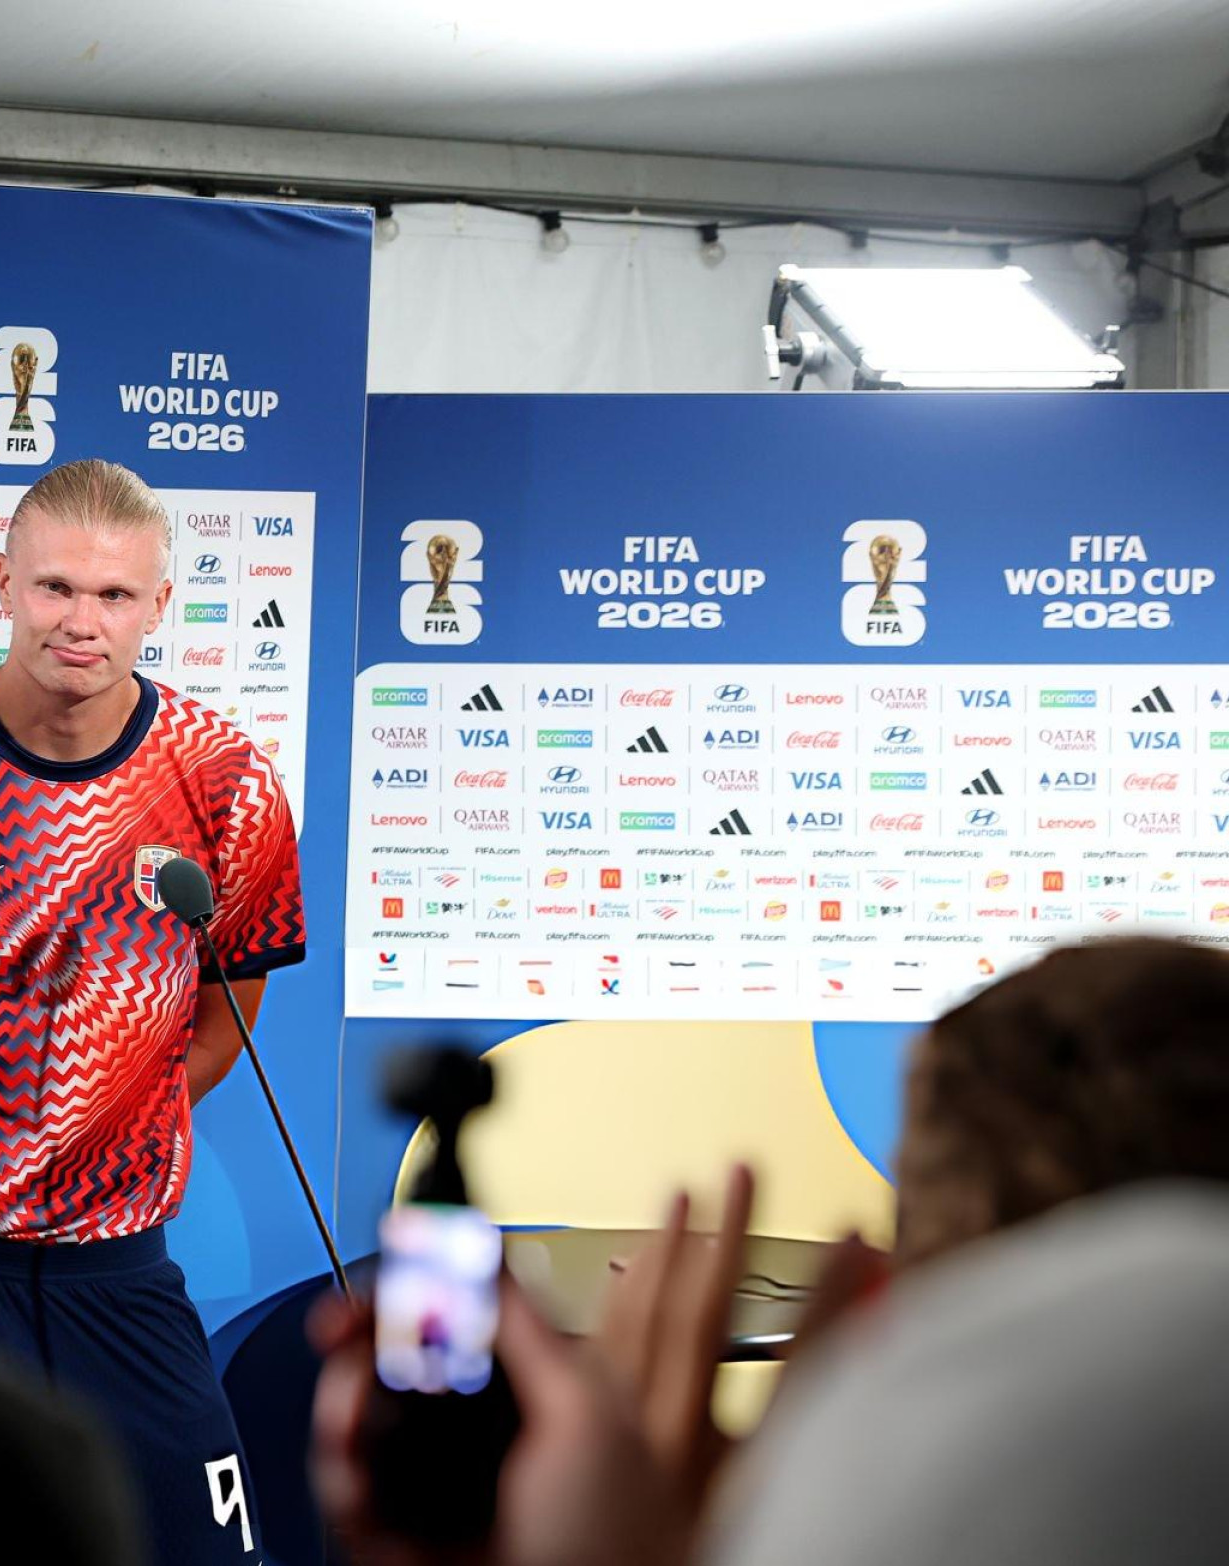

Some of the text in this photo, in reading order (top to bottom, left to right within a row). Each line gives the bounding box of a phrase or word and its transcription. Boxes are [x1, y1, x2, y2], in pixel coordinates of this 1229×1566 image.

[171, 352, 229, 381] FIFA
[119, 385, 278, 417] WORLD CUP
[148, 422, 244, 452] 2026
[7, 438, 37, 452] FIFA
[187, 515, 230, 529] QATAR
[254, 517, 292, 536] VISA
[624, 537, 699, 562] FIFA
[1070, 536, 1147, 562] FIFA
[249, 564, 292, 576] Lenovo
[188, 576, 226, 584] HYUNDAI
[559, 569, 765, 595] WORLD CUP
[1004, 568, 1215, 595] WORLD CUP
[186, 608, 226, 619] aramco
[598, 602, 722, 629] 2026
[1043, 602, 1172, 629] 2026
[424, 621, 459, 632] FIFA
[867, 622, 902, 633] FIFA
[249, 663, 285, 671] HYUNDAI
[374, 692, 426, 702] aramco
[553, 688, 593, 701] ADI
[786, 693, 843, 704] Lenovo
[959, 690, 1011, 707] VISA
[256, 712, 287, 722] verizon
[372, 728, 426, 742] QATAR
[457, 730, 509, 747] VISA
[719, 730, 759, 743] ADI
[1128, 732, 1180, 749] VISA
[619, 774, 676, 786] Lenovo
[790, 772, 842, 789] VISA
[1056, 772, 1096, 785] ADI
[371, 814, 427, 826] Lenovo
[540, 812, 592, 829] VISA
[475, 847, 520, 855] FIFA.com
[204, 1454, 254, 1552] 9
